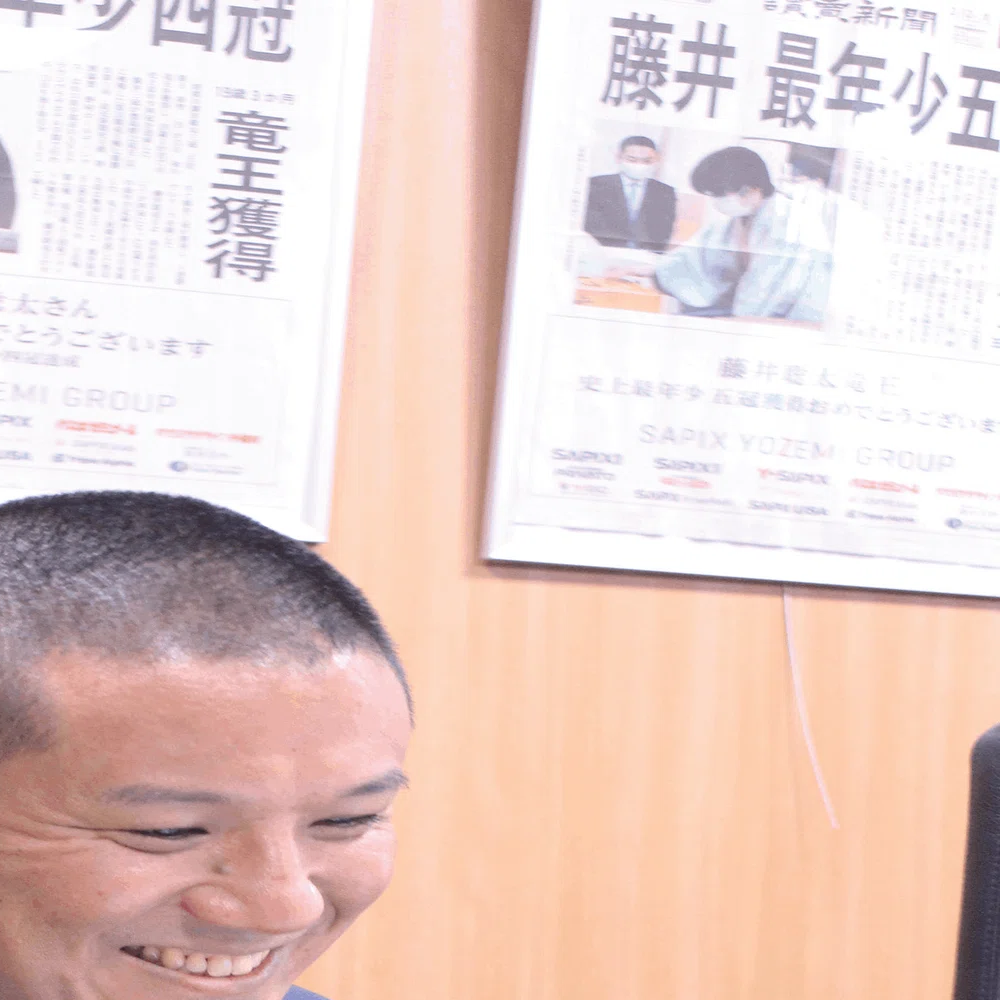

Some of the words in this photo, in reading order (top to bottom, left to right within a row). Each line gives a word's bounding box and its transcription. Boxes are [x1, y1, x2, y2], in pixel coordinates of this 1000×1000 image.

[600, 12, 736, 118] 藤井
[759, 31, 1000, 152] 最年少五
[204, 110, 291, 282] 竜王獲得
[62, 385, 178, 414] GROUP
[639, 423, 730, 451] SAPIX
[855, 446, 958, 474] GROUP
